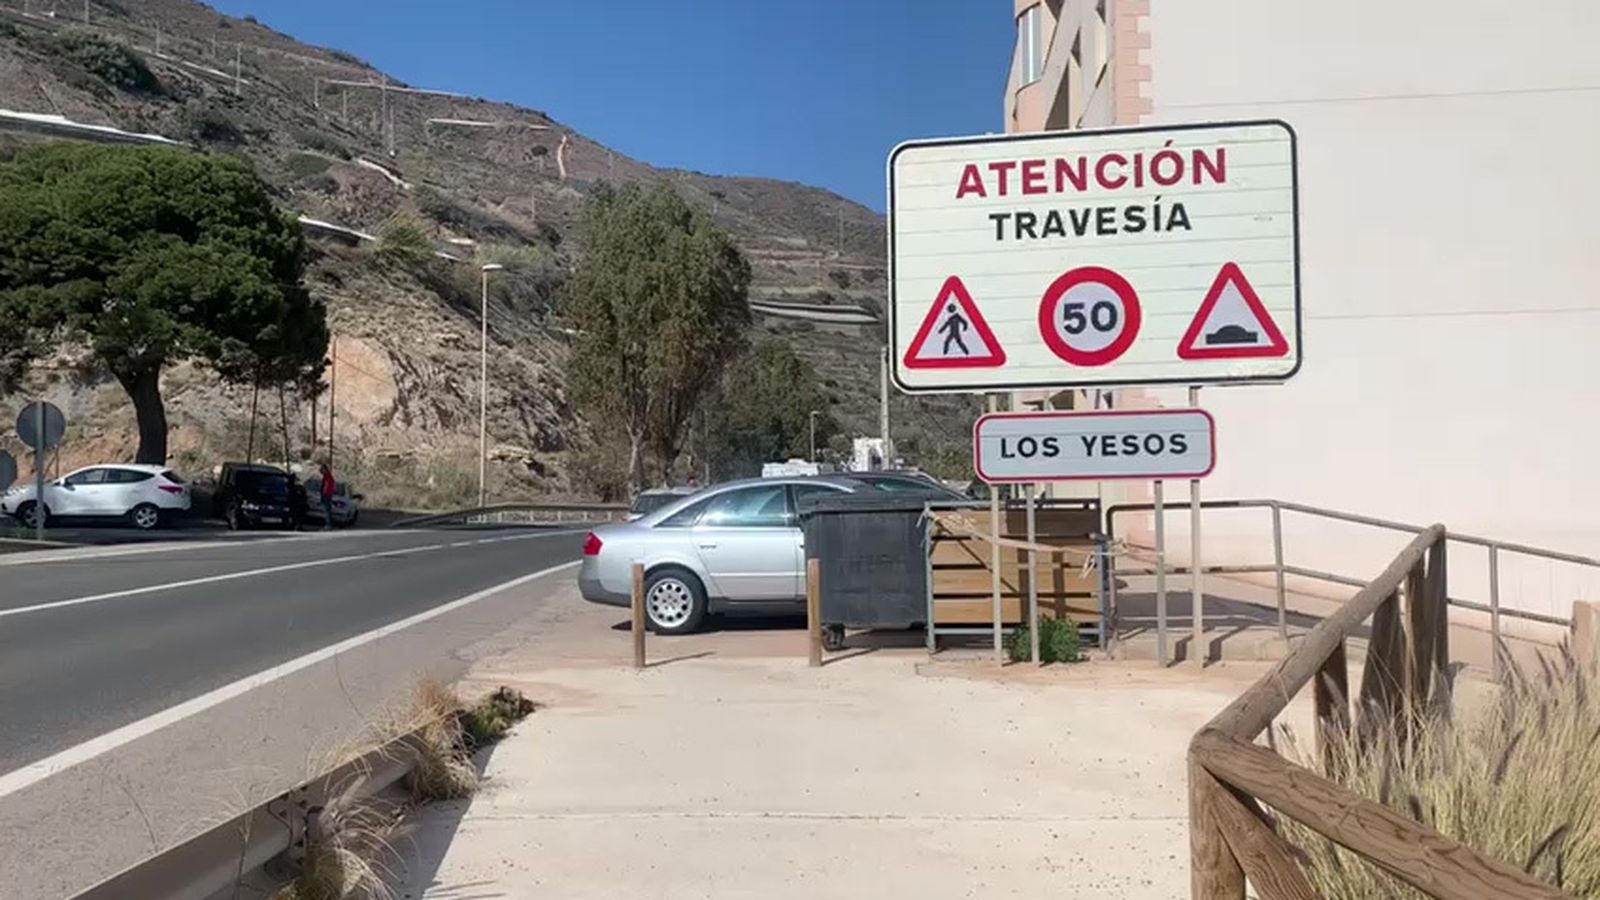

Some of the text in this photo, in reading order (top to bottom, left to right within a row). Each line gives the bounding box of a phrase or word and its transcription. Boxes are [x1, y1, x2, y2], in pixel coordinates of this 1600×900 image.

[955, 140, 1227, 199] ATENCIÓN
[988, 195, 1192, 241] TRAVESÍA
[1063, 302, 1118, 335] 50
[1000, 432, 1188, 459] LOS YESOS
